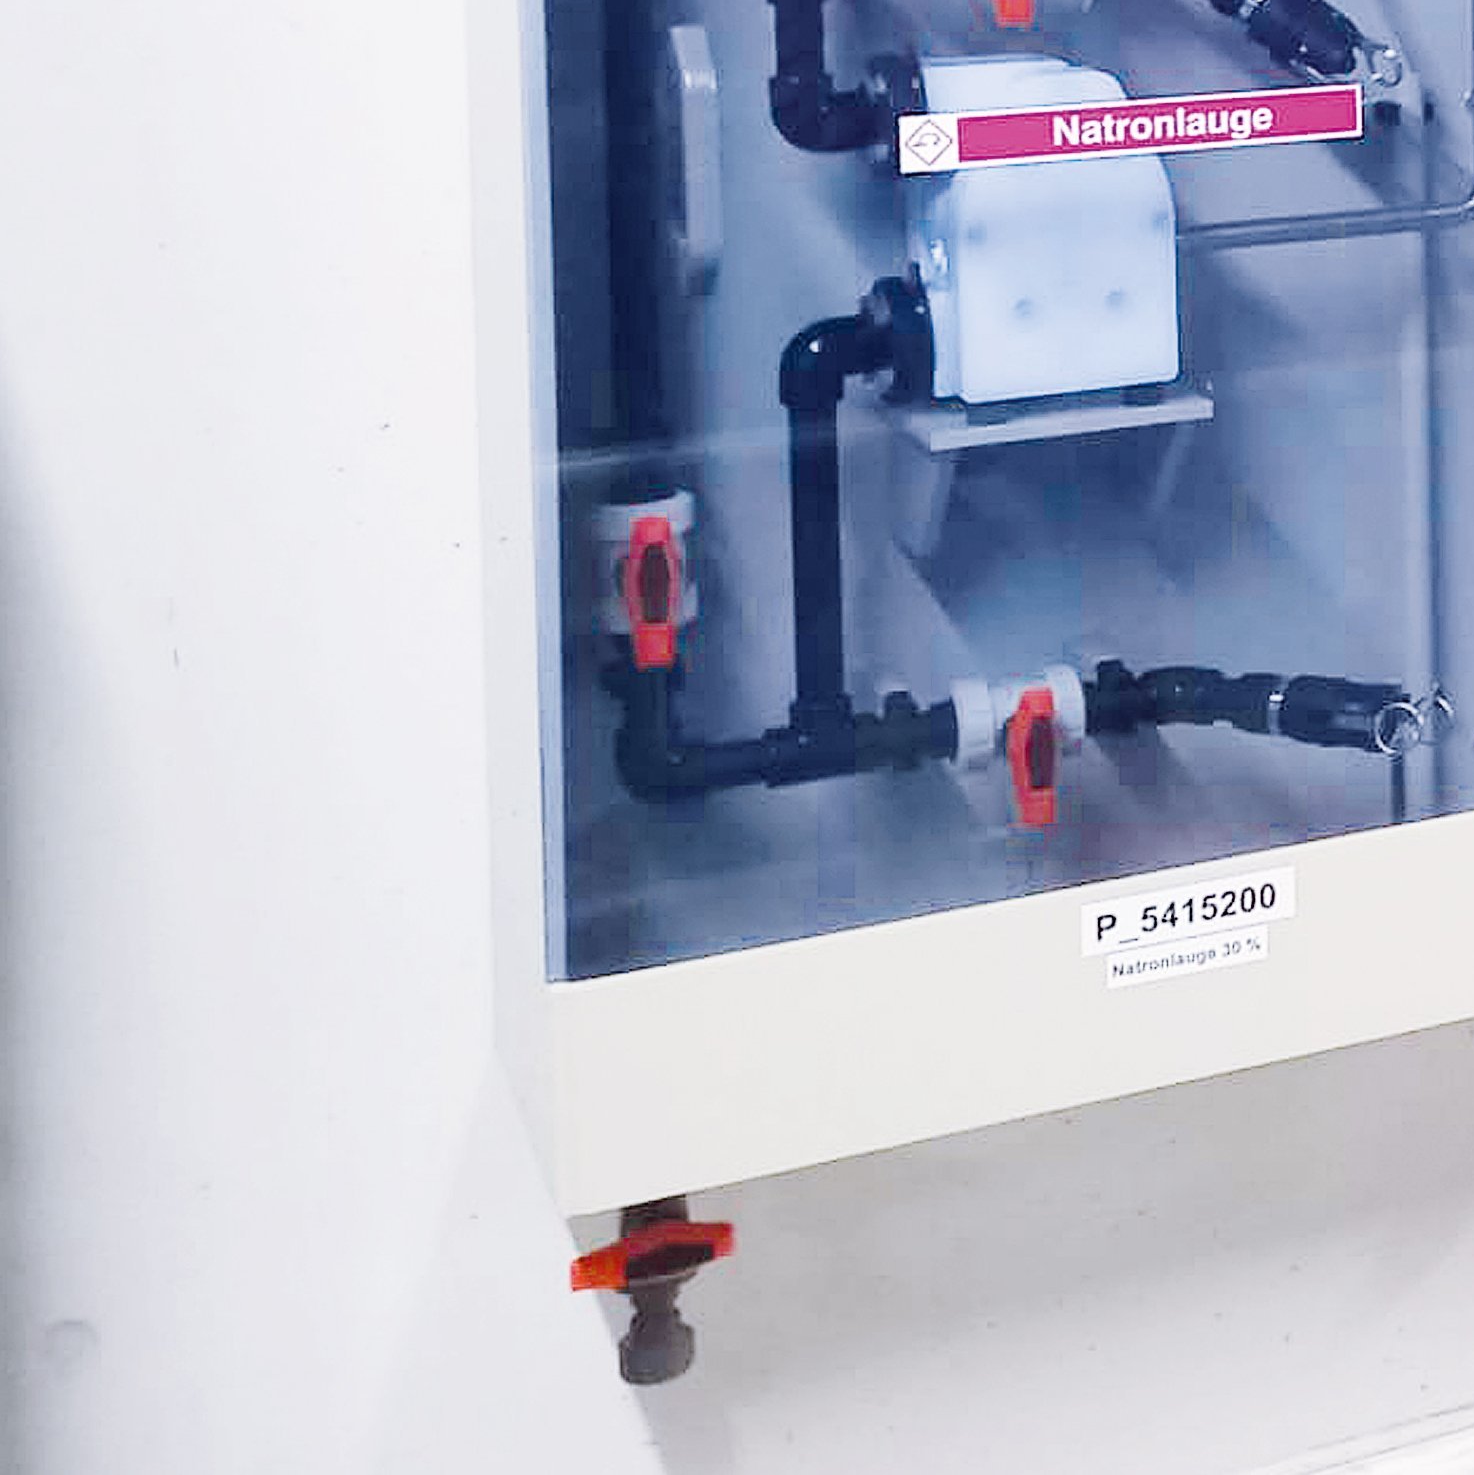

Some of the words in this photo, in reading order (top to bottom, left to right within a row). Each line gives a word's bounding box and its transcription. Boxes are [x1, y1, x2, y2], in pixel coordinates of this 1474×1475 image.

[1053, 107, 1273, 147] Natronlauge
[1096, 882, 1277, 945] P_5415200
[1112, 949, 1217, 978] Natronlauge
[1246, 937, 1262, 952] %
